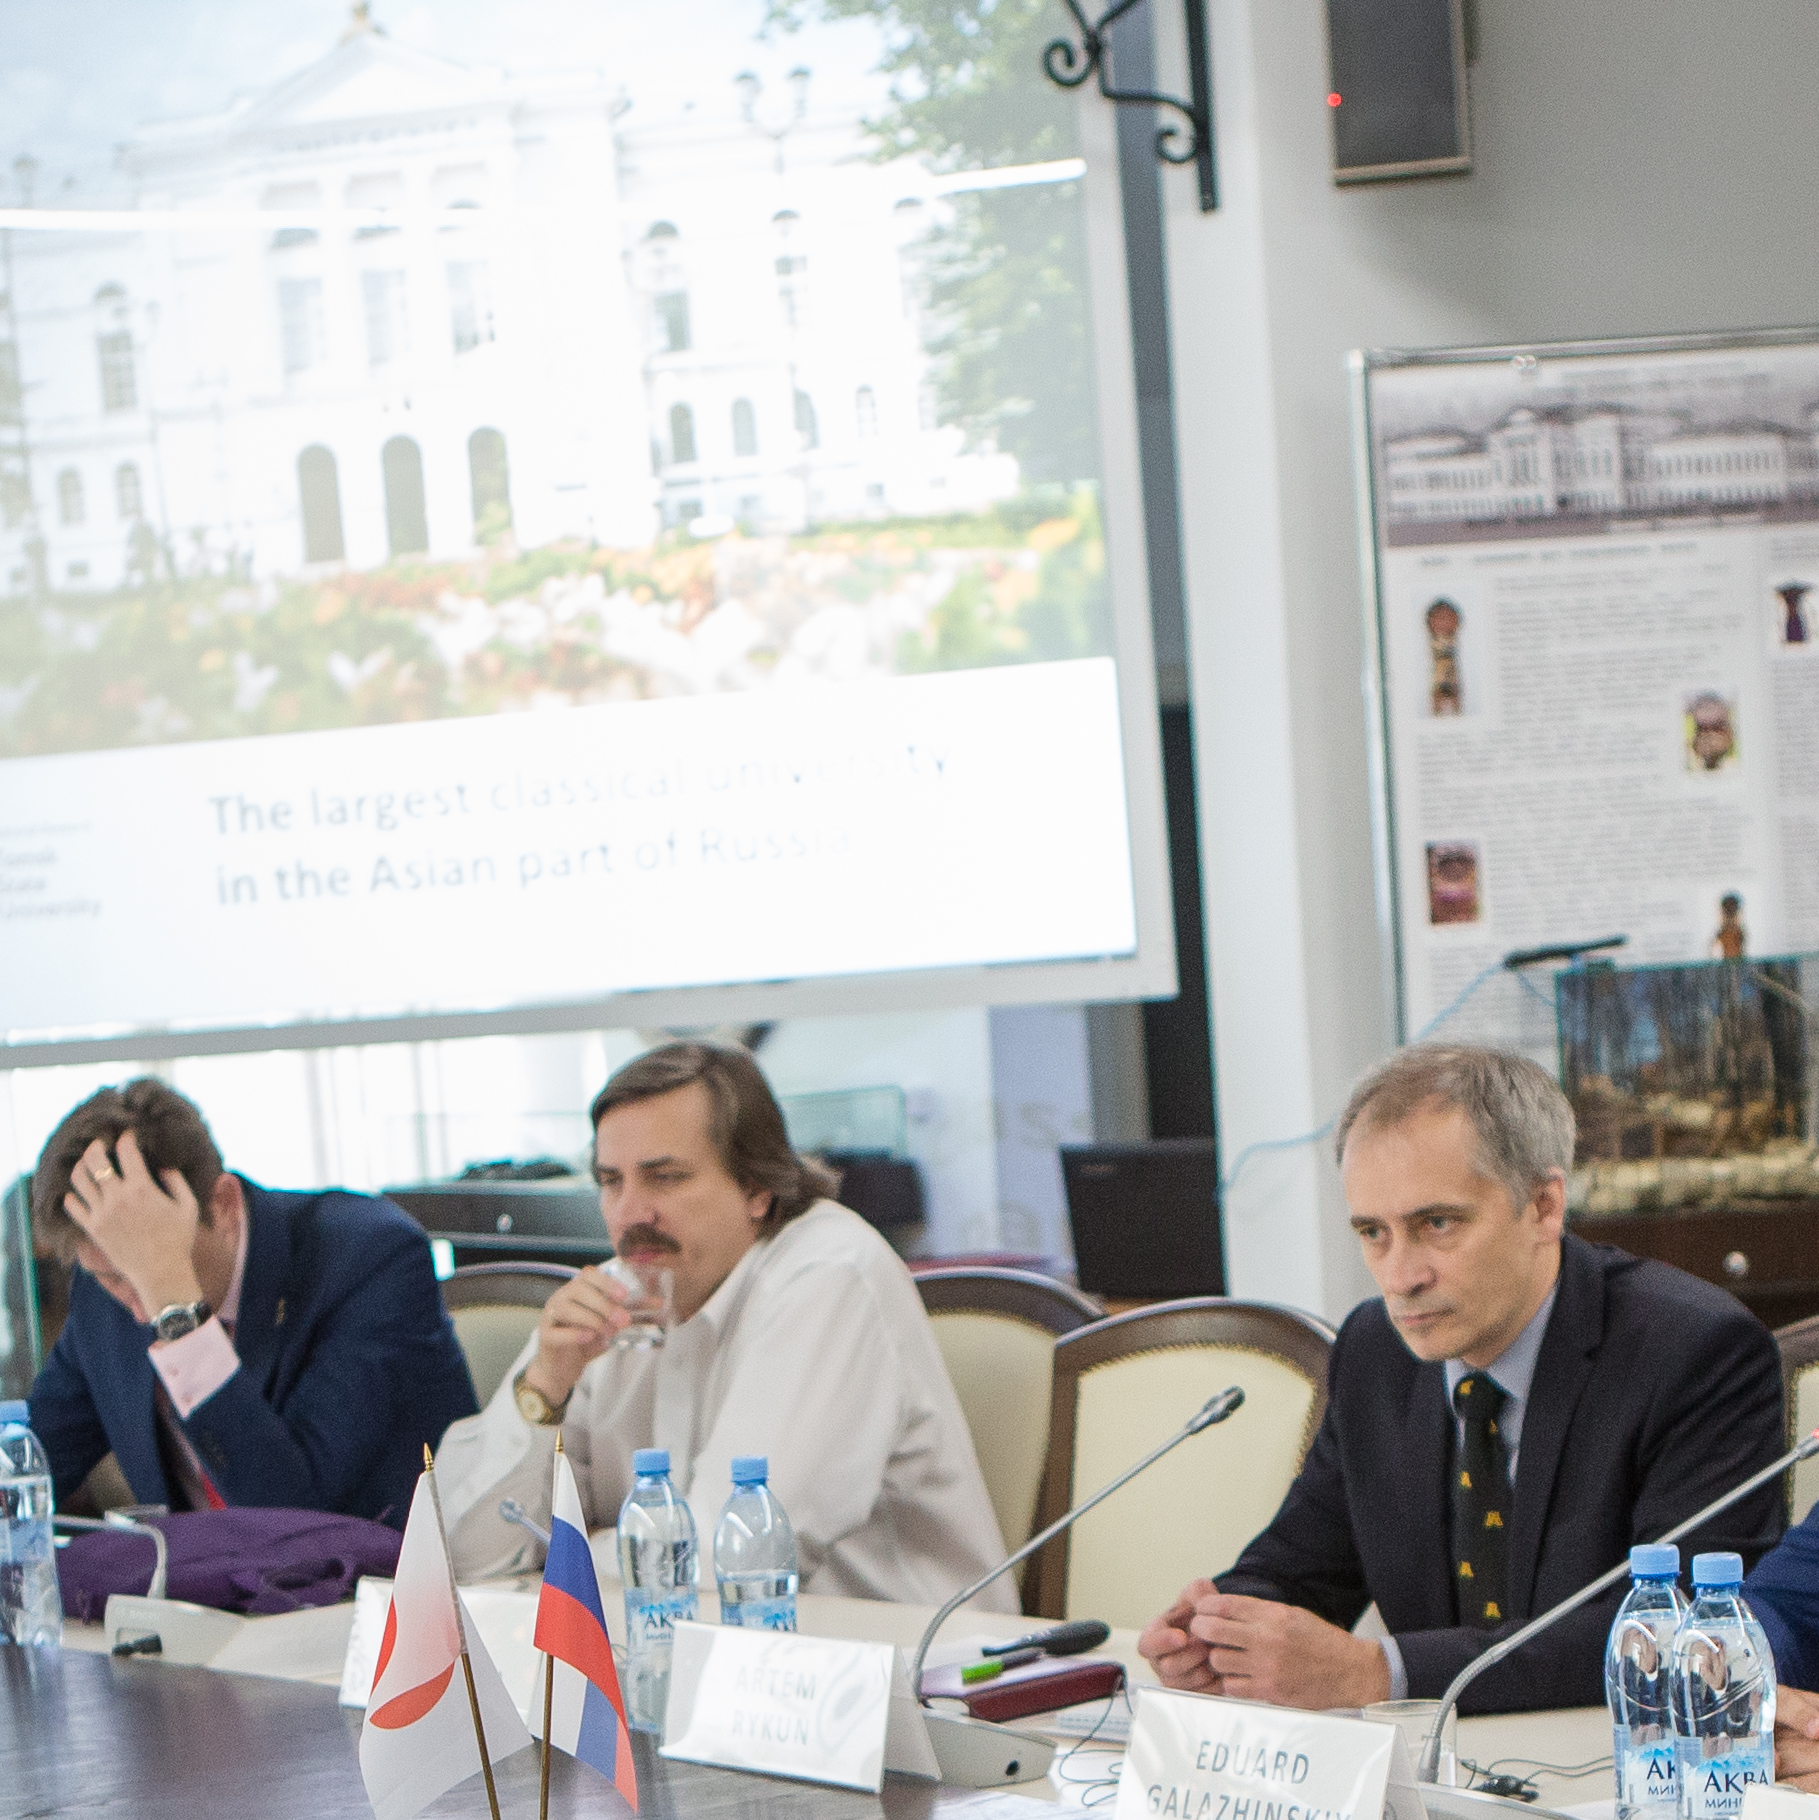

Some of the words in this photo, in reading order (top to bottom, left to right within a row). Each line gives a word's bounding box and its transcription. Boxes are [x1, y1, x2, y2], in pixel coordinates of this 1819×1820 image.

[209, 793, 292, 835] The
[311, 783, 471, 832] largest
[217, 865, 258, 906] in
[274, 859, 351, 902] the
[370, 848, 496, 893] Asian
[518, 841, 612, 889] part
[735, 1664, 816, 1700] ARTEM
[732, 1709, 809, 1746] RYKUN
[1196, 1740, 1309, 1784] EDUARD
